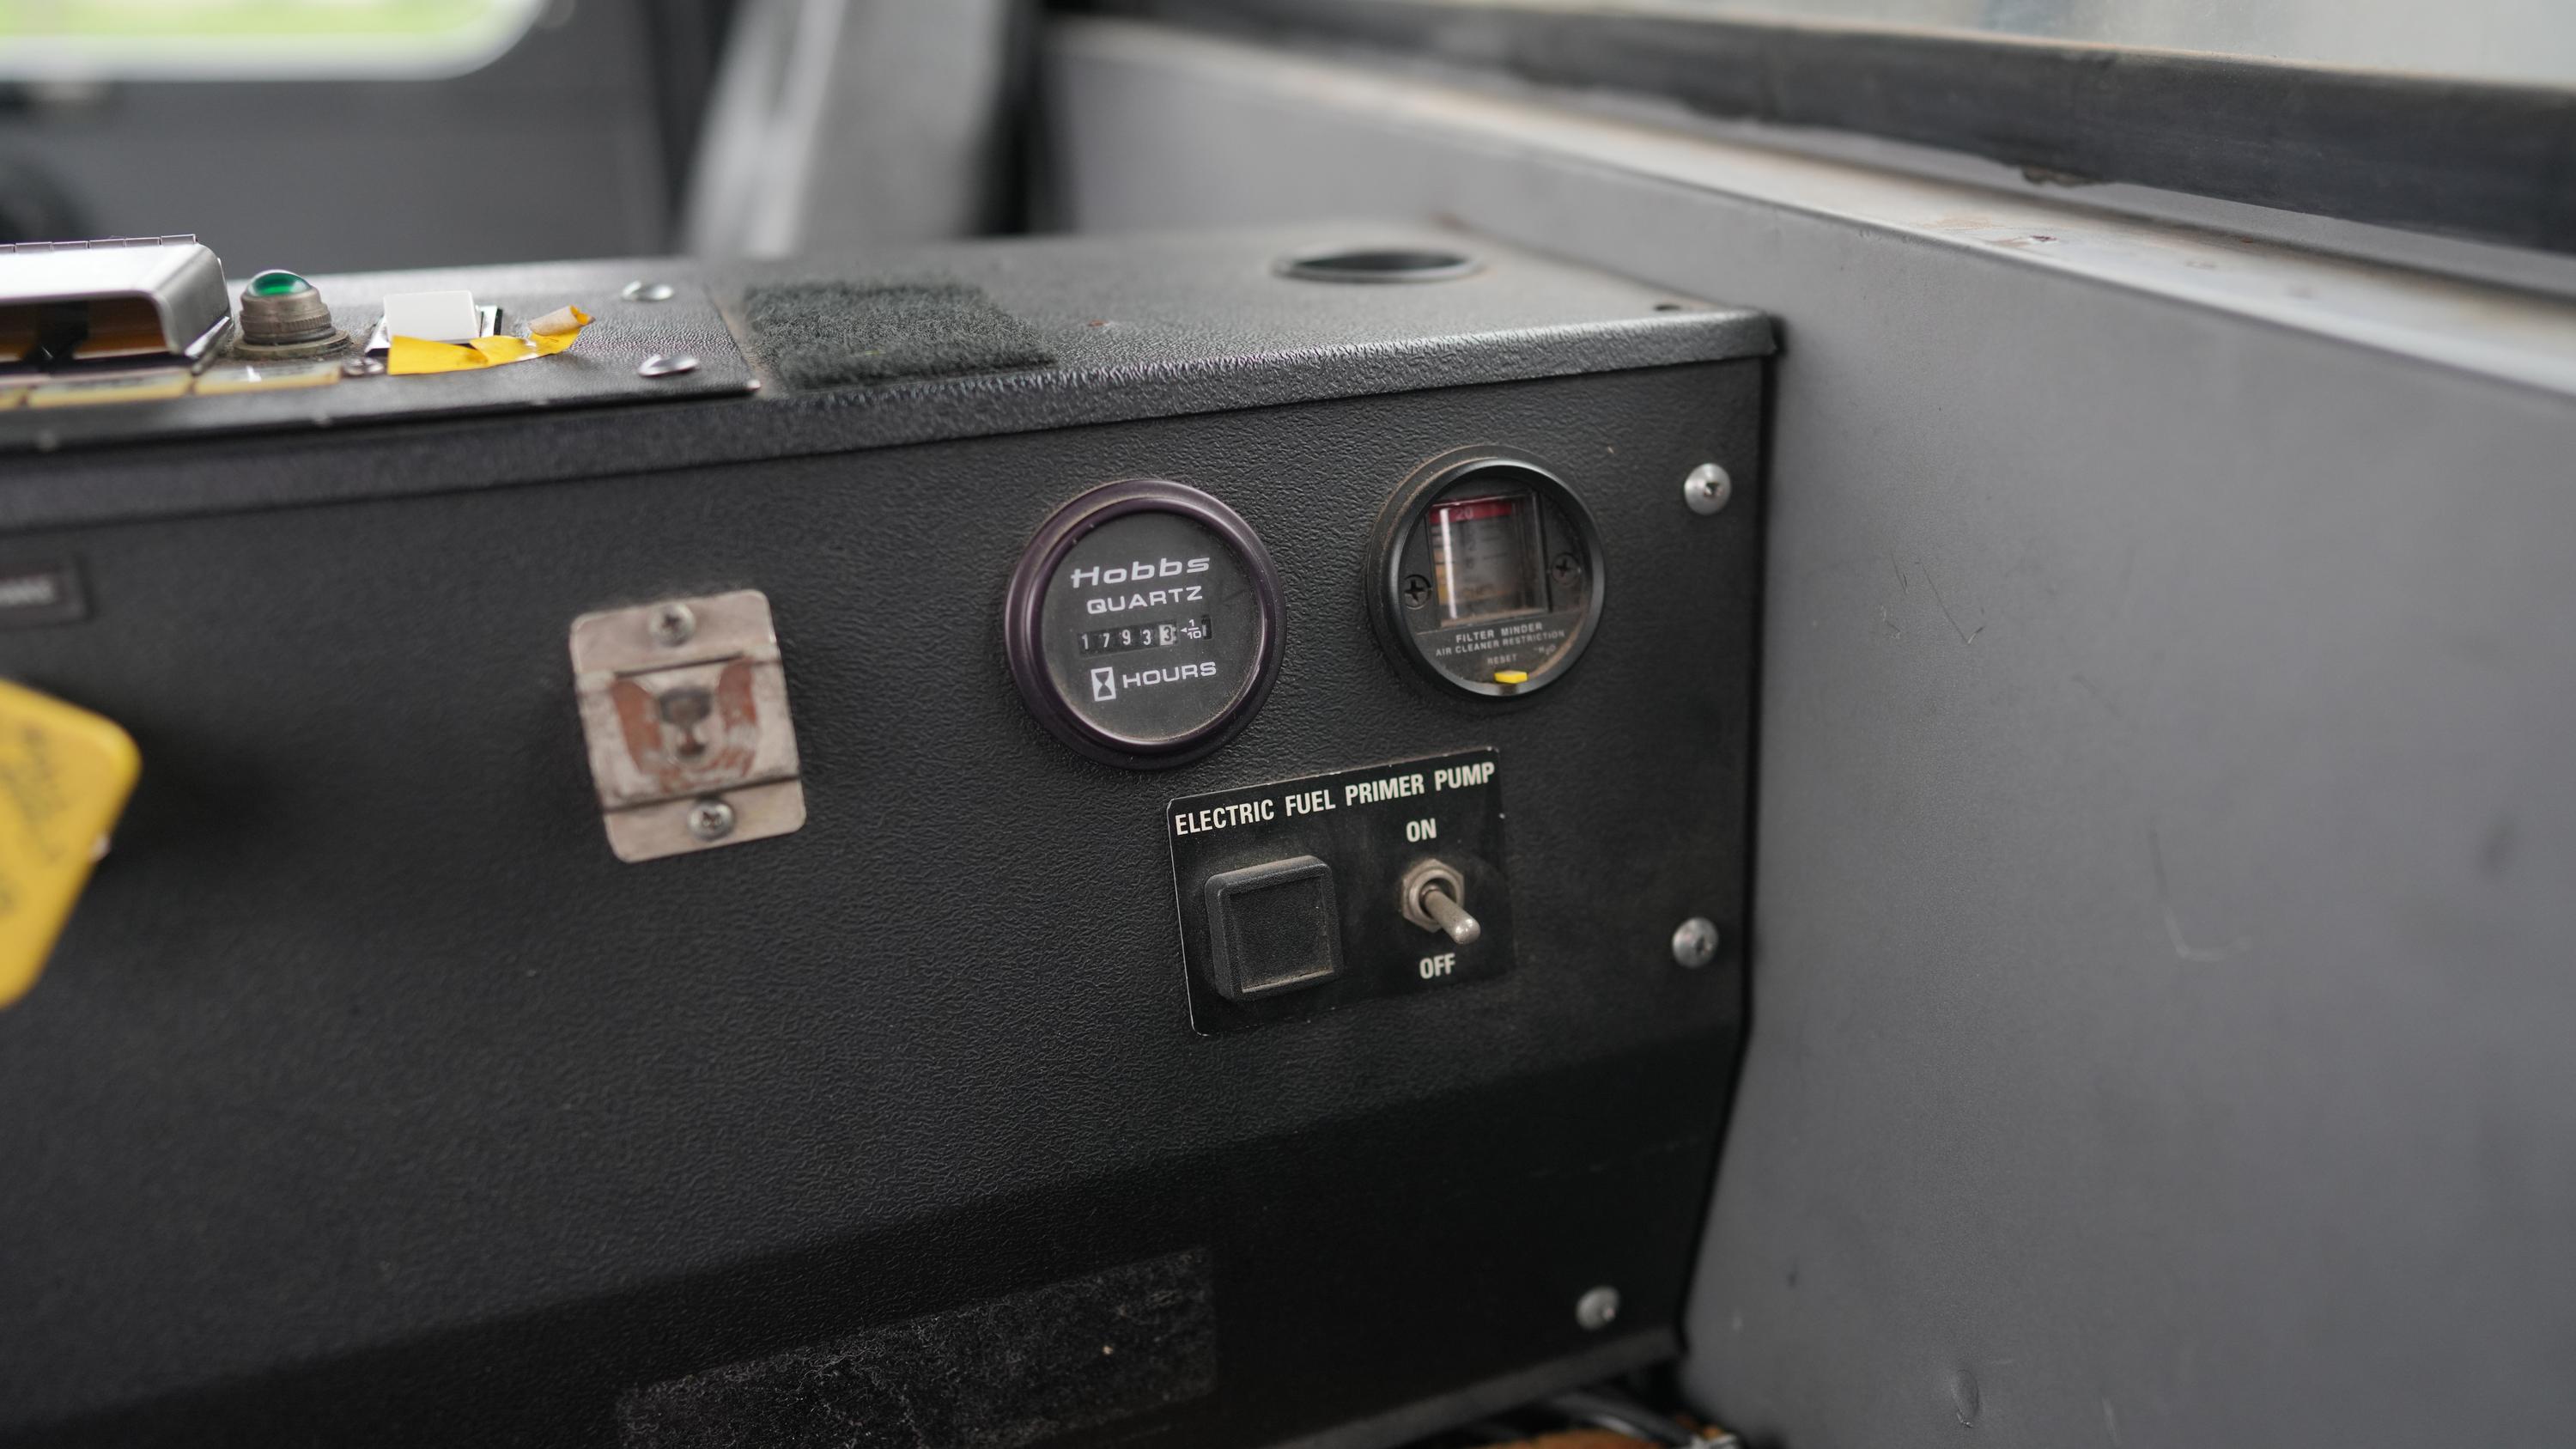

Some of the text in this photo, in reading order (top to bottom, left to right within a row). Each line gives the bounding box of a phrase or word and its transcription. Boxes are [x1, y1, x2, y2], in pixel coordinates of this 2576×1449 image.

[1071, 557, 1210, 588] Hobbs
[1087, 586, 1203, 614] QUARTZ
[1436, 630, 1565, 657] AIR CLEANER RESTRICTION
[1456, 622, 1543, 643] FILTER MINDER
[1487, 654, 1517, 665] RESET
[1123, 661, 1217, 688] HOURS
[1175, 762, 1495, 836] ELECTRIC FUEL PRIMER PUMP
[1406, 818, 1437, 843] ON
[1419, 953, 1456, 980] OFF
